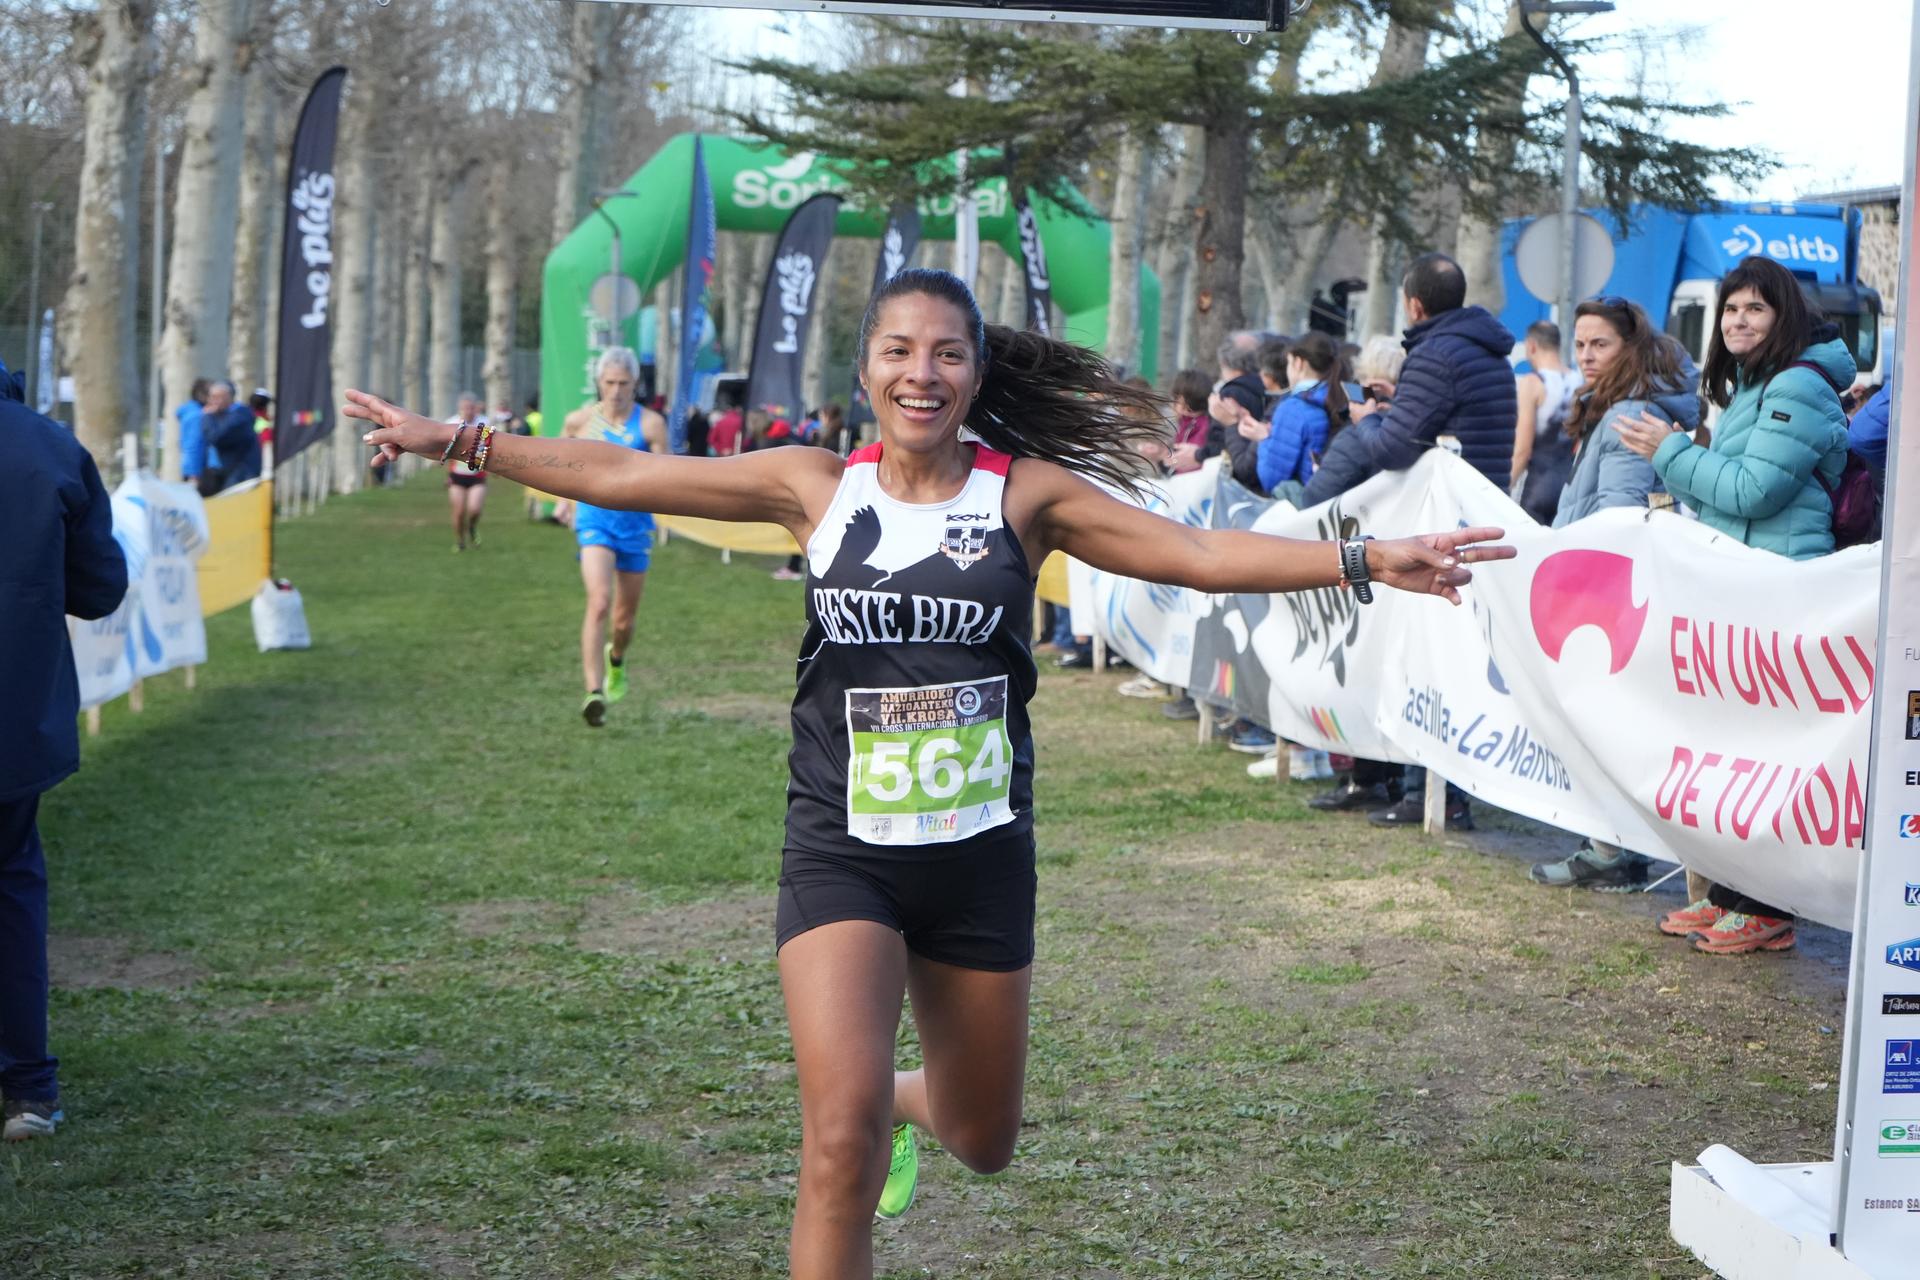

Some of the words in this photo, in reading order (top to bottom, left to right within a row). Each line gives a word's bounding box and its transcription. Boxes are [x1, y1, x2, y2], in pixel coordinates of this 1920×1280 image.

[1767, 233, 1840, 263] eitb
[813, 588, 903, 645] BESTE
[908, 595, 1004, 646] BIRA
[1671, 616, 1725, 700] EN
[1728, 624, 1799, 711] UN
[1794, 634, 1877, 714] LU
[880, 688, 954, 703] AMURRIOKO
[880, 699, 954, 713] NAZIOARTEKO
[871, 724, 881, 733] VII
[881, 723, 904, 733] CROSS
[905, 719, 960, 732] INTERNACIONAL
[866, 728, 1009, 801] 564
[1656, 746, 1723, 829] DE
[1715, 758, 1783, 841] TU
[916, 813, 958, 833] Vital
[1864, 1198, 1903, 1209] Estanco
